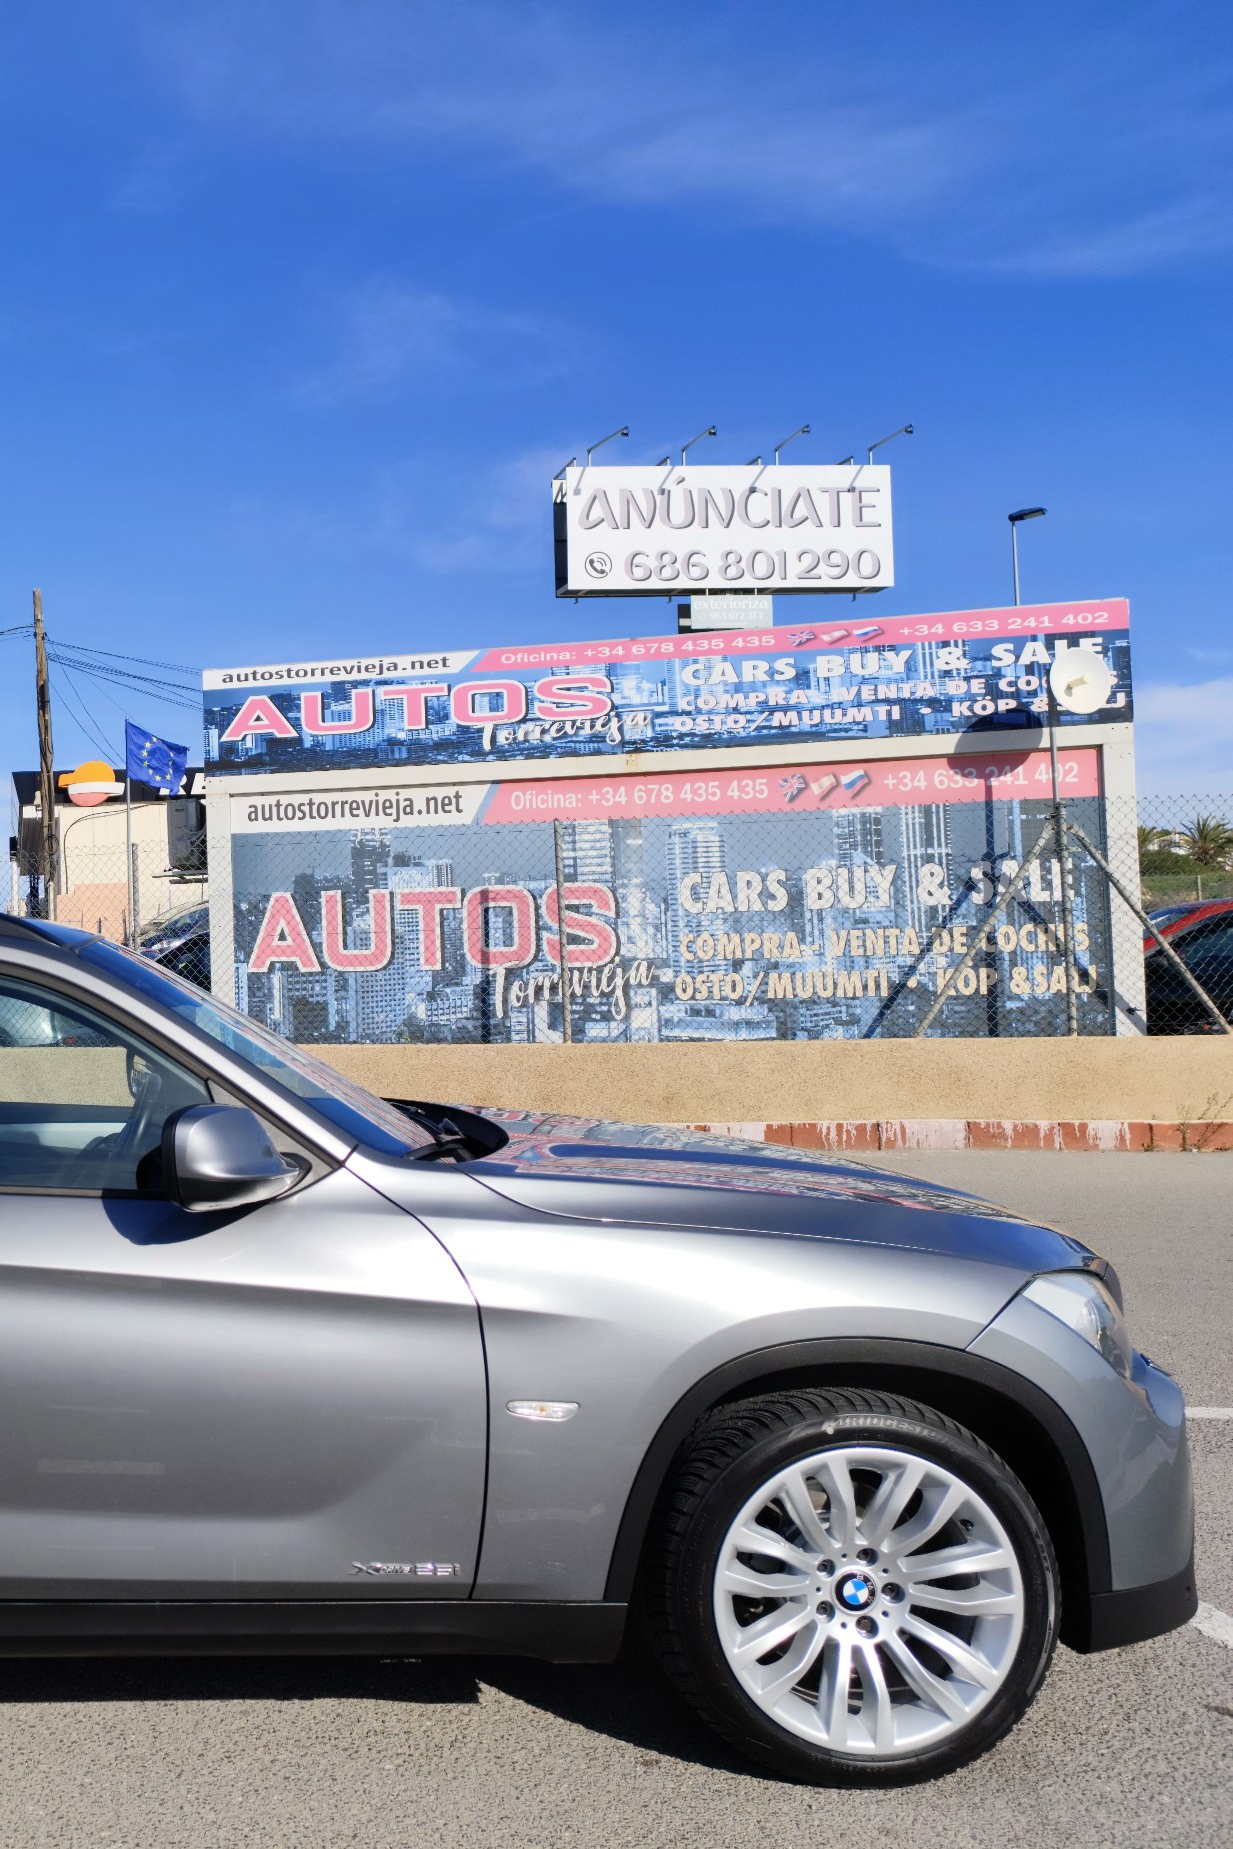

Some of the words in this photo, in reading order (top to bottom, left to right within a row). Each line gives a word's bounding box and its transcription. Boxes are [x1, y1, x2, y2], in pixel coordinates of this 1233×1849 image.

[578, 475, 881, 530] ANÚNCIATE
[624, 550, 709, 581] 686
[718, 549, 787, 580] 801
[796, 549, 881, 580] 290
[899, 622, 945, 636] +34
[952, 619, 999, 633] 633
[1007, 615, 1054, 629] 241
[1060, 611, 1109, 625] 402
[501, 649, 576, 664] Oficina:
[583, 644, 628, 658] +34
[631, 642, 674, 655] 678
[681, 638, 725, 651] 435
[733, 635, 775, 648] 435
[681, 657, 797, 686] CARS
[817, 649, 913, 678] BUY
[934, 646, 971, 670] &
[222, 656, 450, 684] autostorrevieja.net
[220, 675, 614, 742] AUTOS
[681, 689, 810, 711] COMPRA
[840, 681, 937, 701] VENTA
[949, 676, 986, 695] DE
[952, 696, 1018, 718] KÖP
[478, 708, 653, 750] Torrevieja
[884, 771, 927, 791] +34
[934, 768, 979, 790] 633
[985, 764, 1029, 786] 241
[248, 790, 463, 823] autostorrevieja.net
[511, 789, 582, 811] Oficina:
[588, 786, 628, 806] +34
[633, 784, 674, 804] 678
[680, 781, 720, 802] 435
[727, 778, 768, 799] 435
[680, 869, 789, 914] CARS
[806, 864, 898, 910] BUY
[917, 862, 953, 906] &
[248, 883, 621, 973] AUTOS
[680, 931, 802, 960] COMPRA
[829, 927, 921, 956] VENTA
[931, 926, 968, 954] DE
